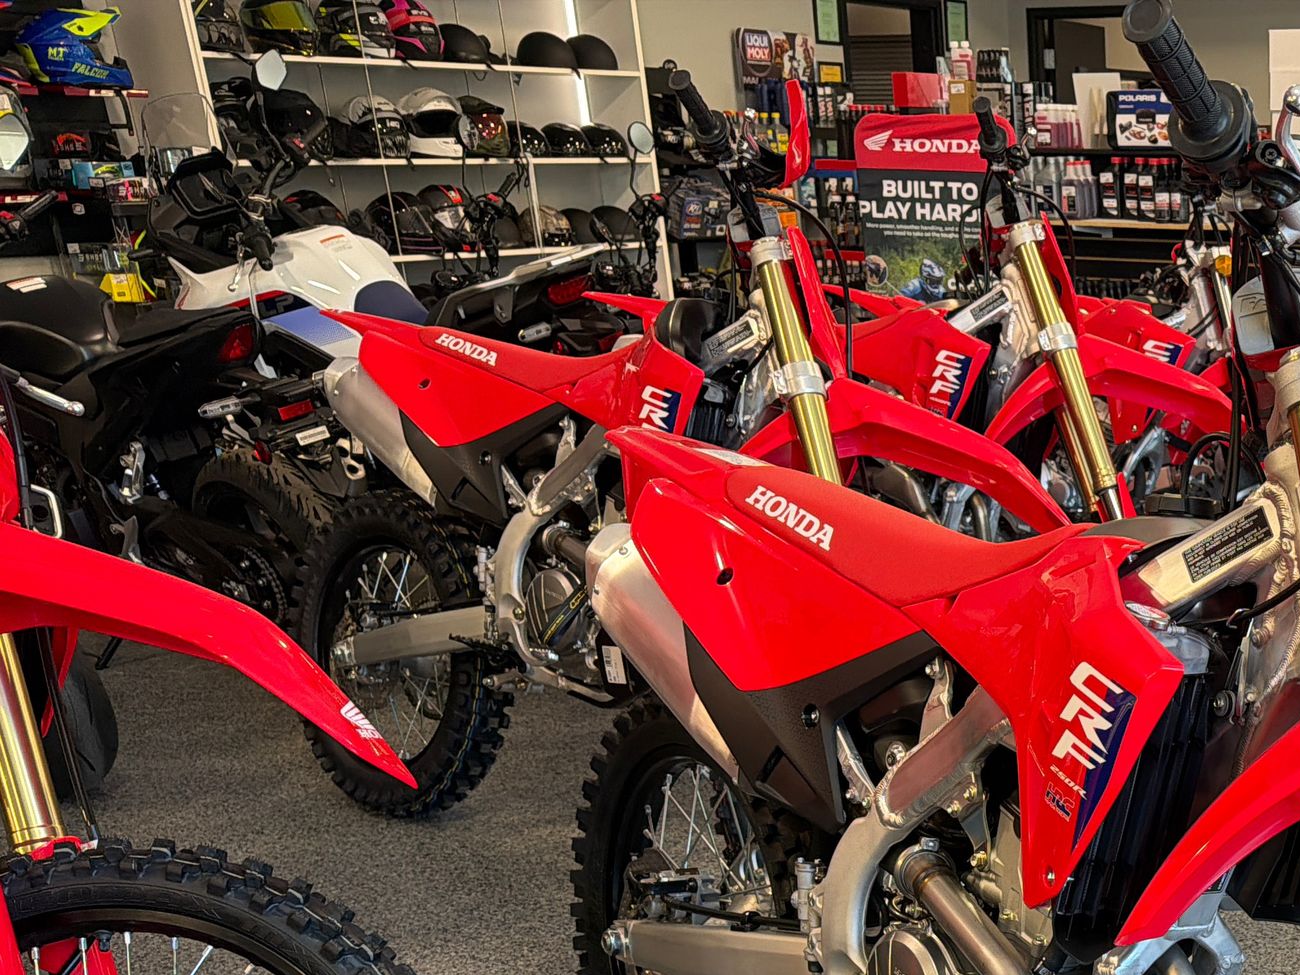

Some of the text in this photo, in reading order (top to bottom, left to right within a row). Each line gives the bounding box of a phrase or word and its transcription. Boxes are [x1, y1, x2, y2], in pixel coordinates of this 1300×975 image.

[745, 34, 768, 46] LIQUI
[48, 47, 64, 57] MT
[747, 48, 770, 59] MOLY
[71, 62, 109, 79] FALCON
[1119, 94, 1157, 102] POLARIS
[892, 138, 981, 153] HONDA
[882, 179, 978, 201] BUILT TO
[859, 201, 911, 220] PLAY
[435, 333, 498, 367] HONDA
[641, 385, 672, 432] CR
[745, 485, 834, 551] HONDA
[1052, 661, 1124, 770] CRF
[1050, 764, 1088, 800] 250R
